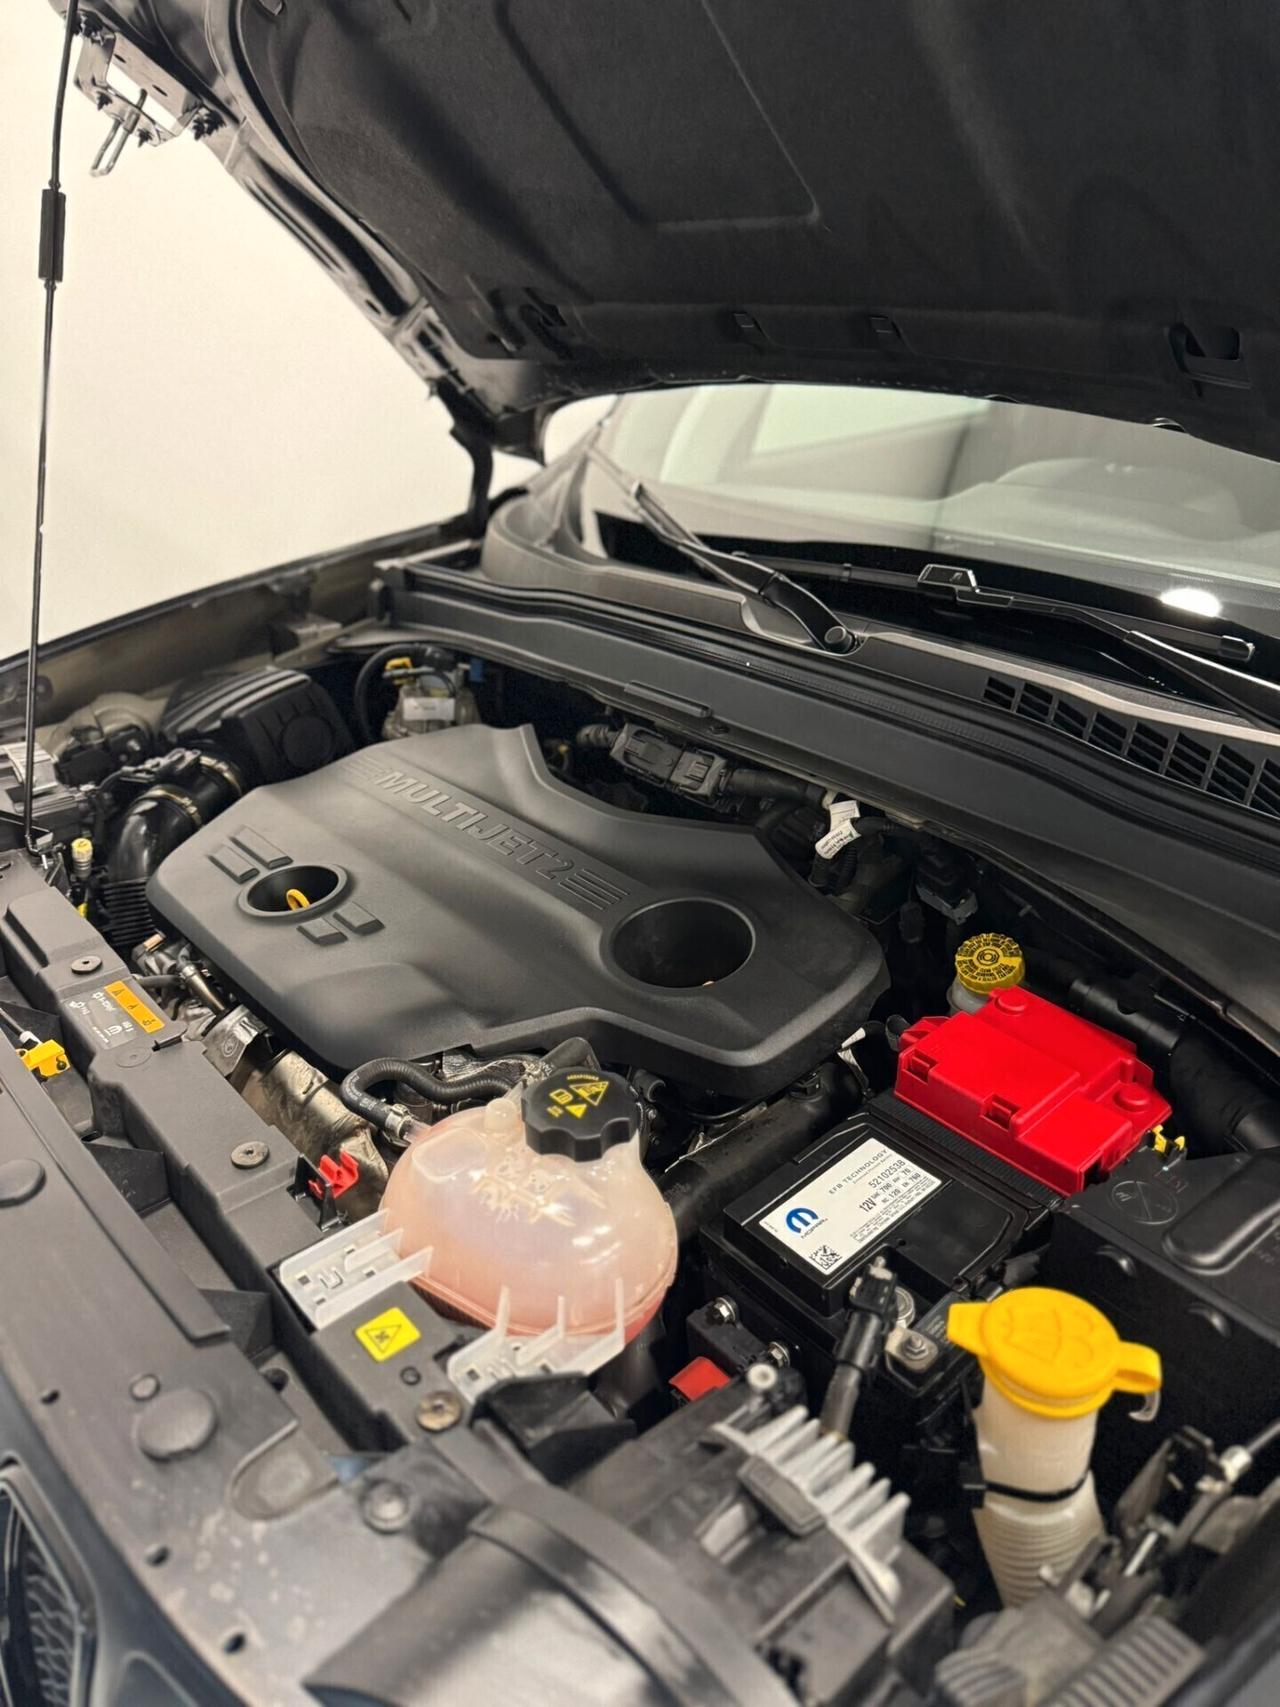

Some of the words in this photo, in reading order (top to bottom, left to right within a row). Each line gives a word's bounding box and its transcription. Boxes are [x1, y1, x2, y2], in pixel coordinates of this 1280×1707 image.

[829, 1183, 844, 1194] EFB
[843, 1149, 888, 1184] TECHNOLOGY
[858, 1198, 877, 1212] 12V
